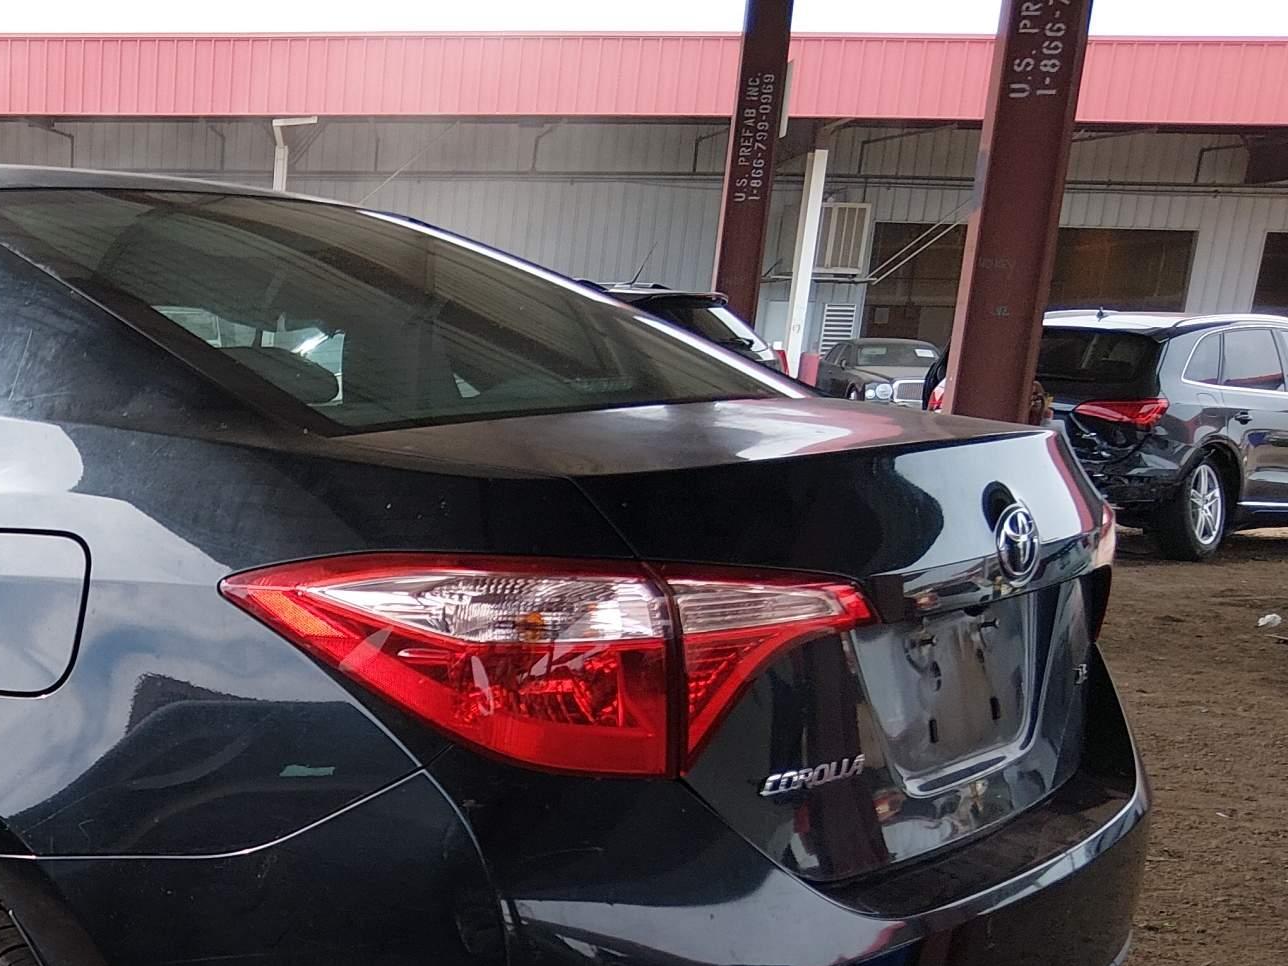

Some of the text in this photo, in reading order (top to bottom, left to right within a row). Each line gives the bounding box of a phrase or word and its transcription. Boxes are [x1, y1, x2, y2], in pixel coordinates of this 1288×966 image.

[1008, 50, 1037, 98] U.S.
[733, 72, 762, 202] U.S. PREFAB INC.
[748, 73, 775, 201] 1-866-799-0969
[759, 753, 866, 797] COROLLA
